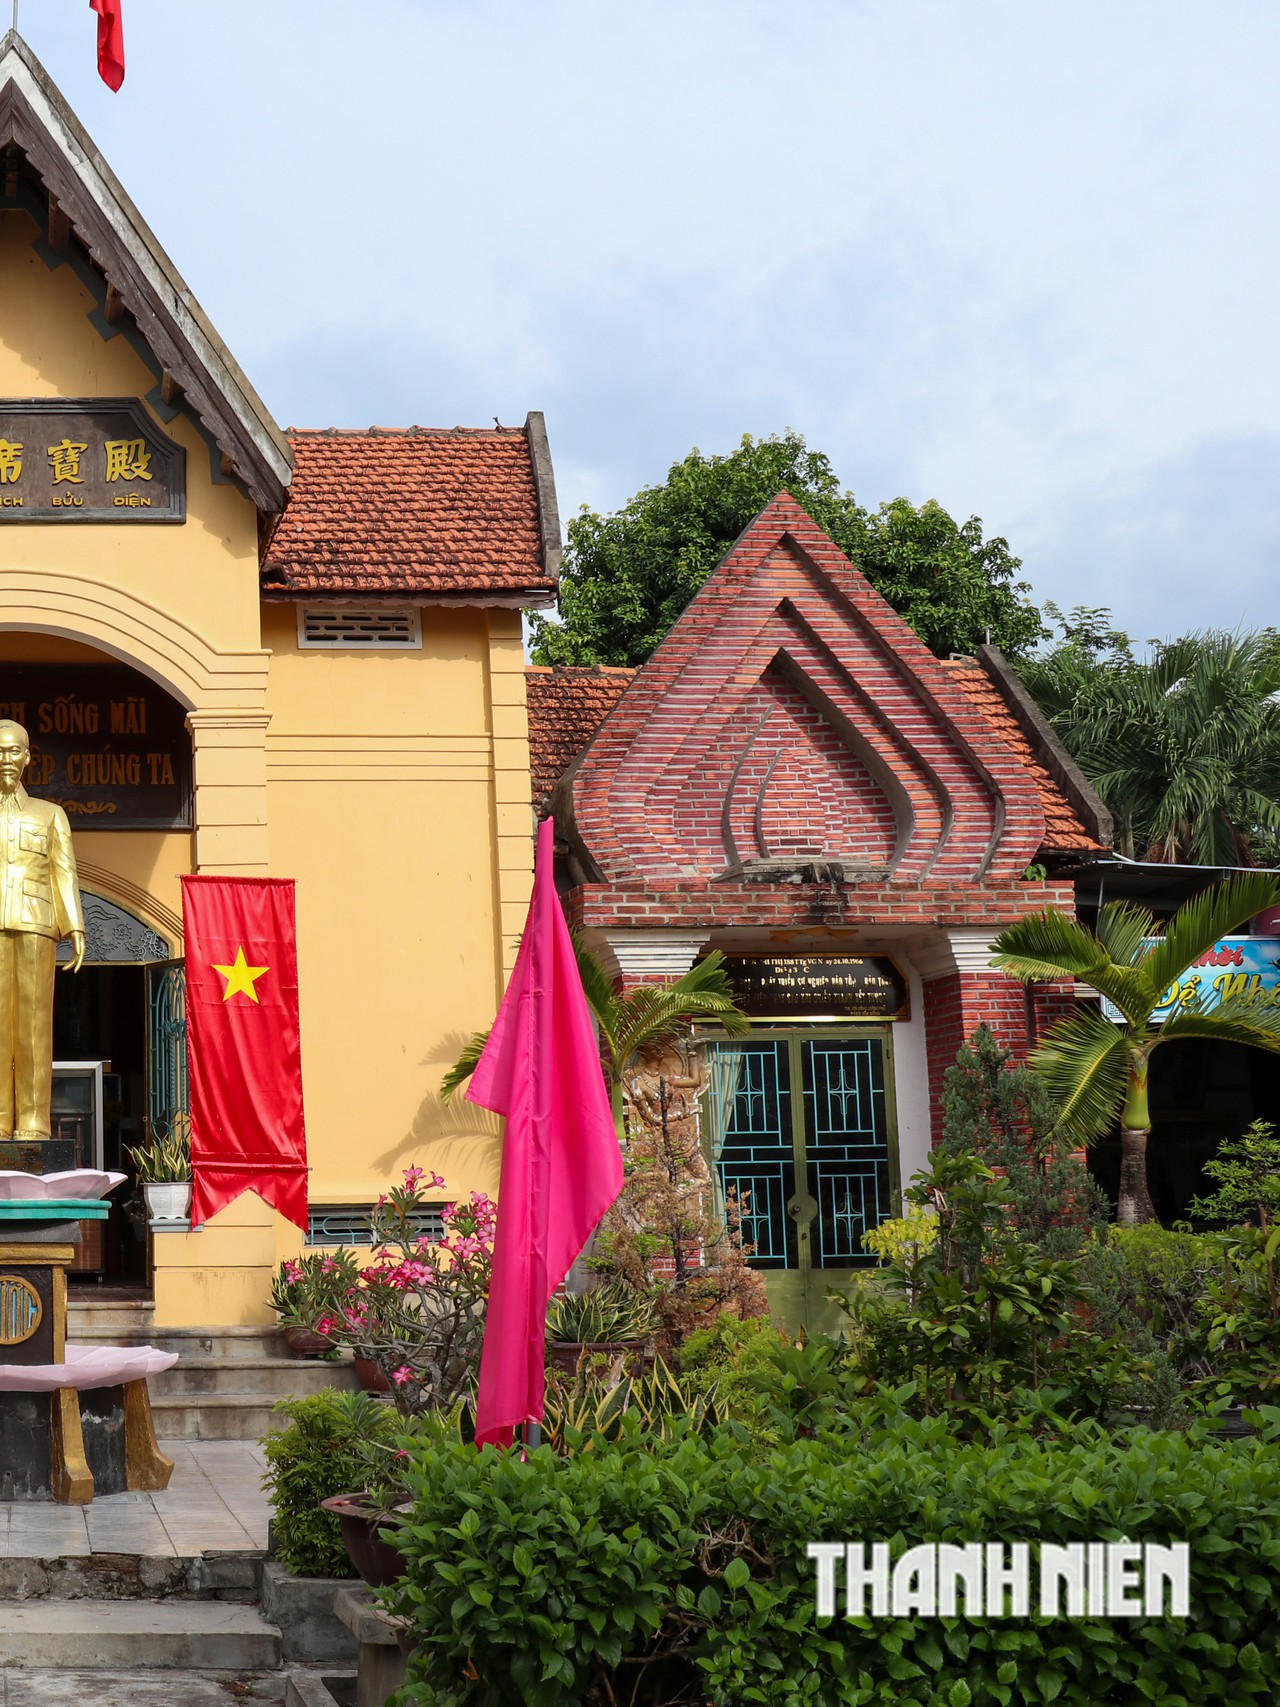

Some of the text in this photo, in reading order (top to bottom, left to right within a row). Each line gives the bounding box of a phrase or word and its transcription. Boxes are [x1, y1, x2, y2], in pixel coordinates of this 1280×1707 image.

[51, 490, 83, 506] BỬU
[113, 492, 152, 508] ĐIỆN
[37, 693, 100, 735] SỐNG
[110, 695, 148, 735] MÃI
[65, 743, 142, 787] CHÚNG
[146, 752, 176, 786] TA
